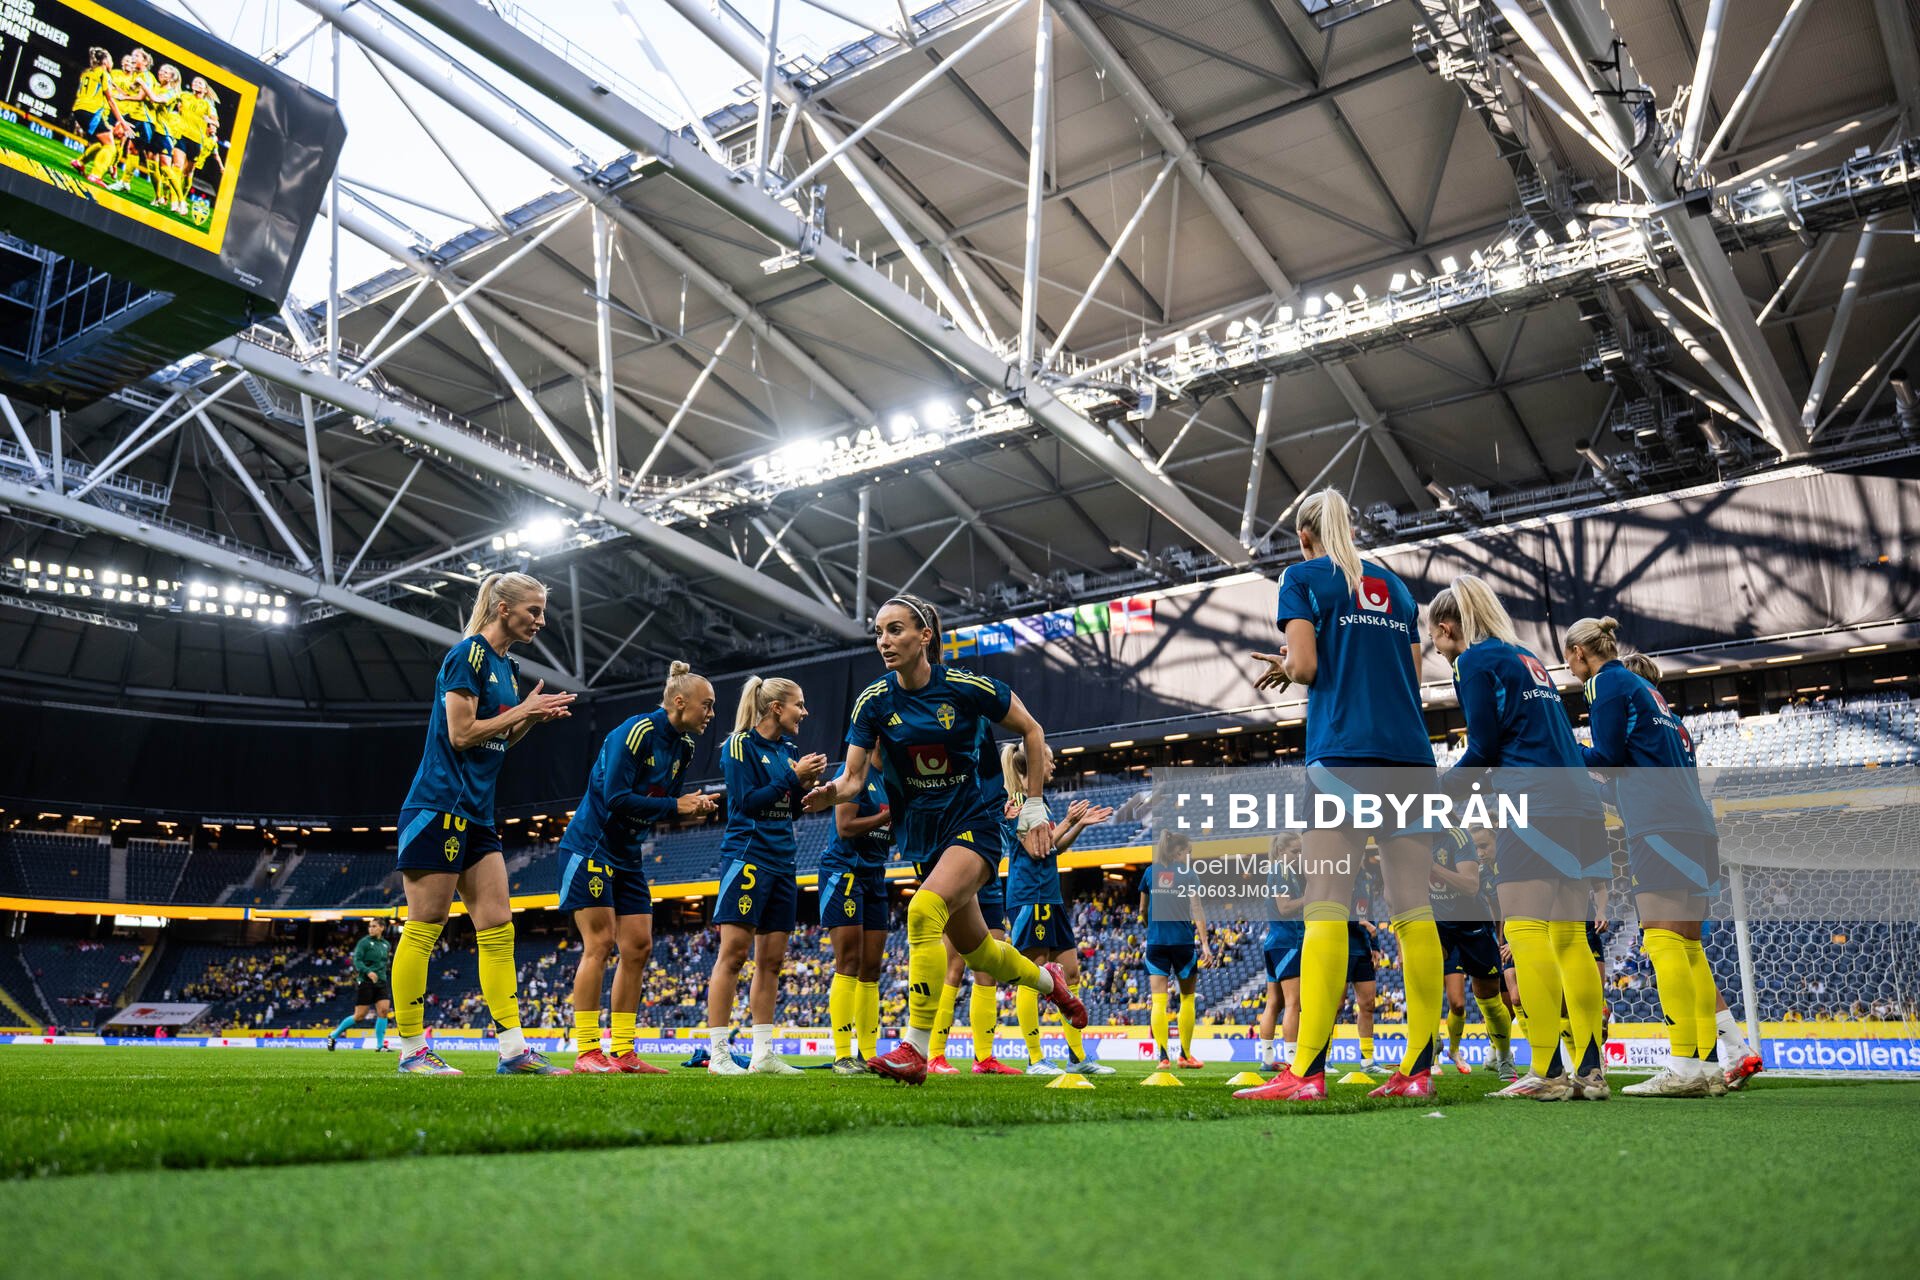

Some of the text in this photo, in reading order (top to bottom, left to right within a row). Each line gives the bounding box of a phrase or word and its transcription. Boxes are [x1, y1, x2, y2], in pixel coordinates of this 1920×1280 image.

[1339, 614, 1410, 635] SVENSKA SPEL
[982, 631, 1009, 647] FIFA
[740, 863, 758, 891] 5
[842, 872, 855, 897] 7
[1630, 1046, 1671, 1055] SVENSK
[1773, 1041, 1920, 1066] Fotbollens
